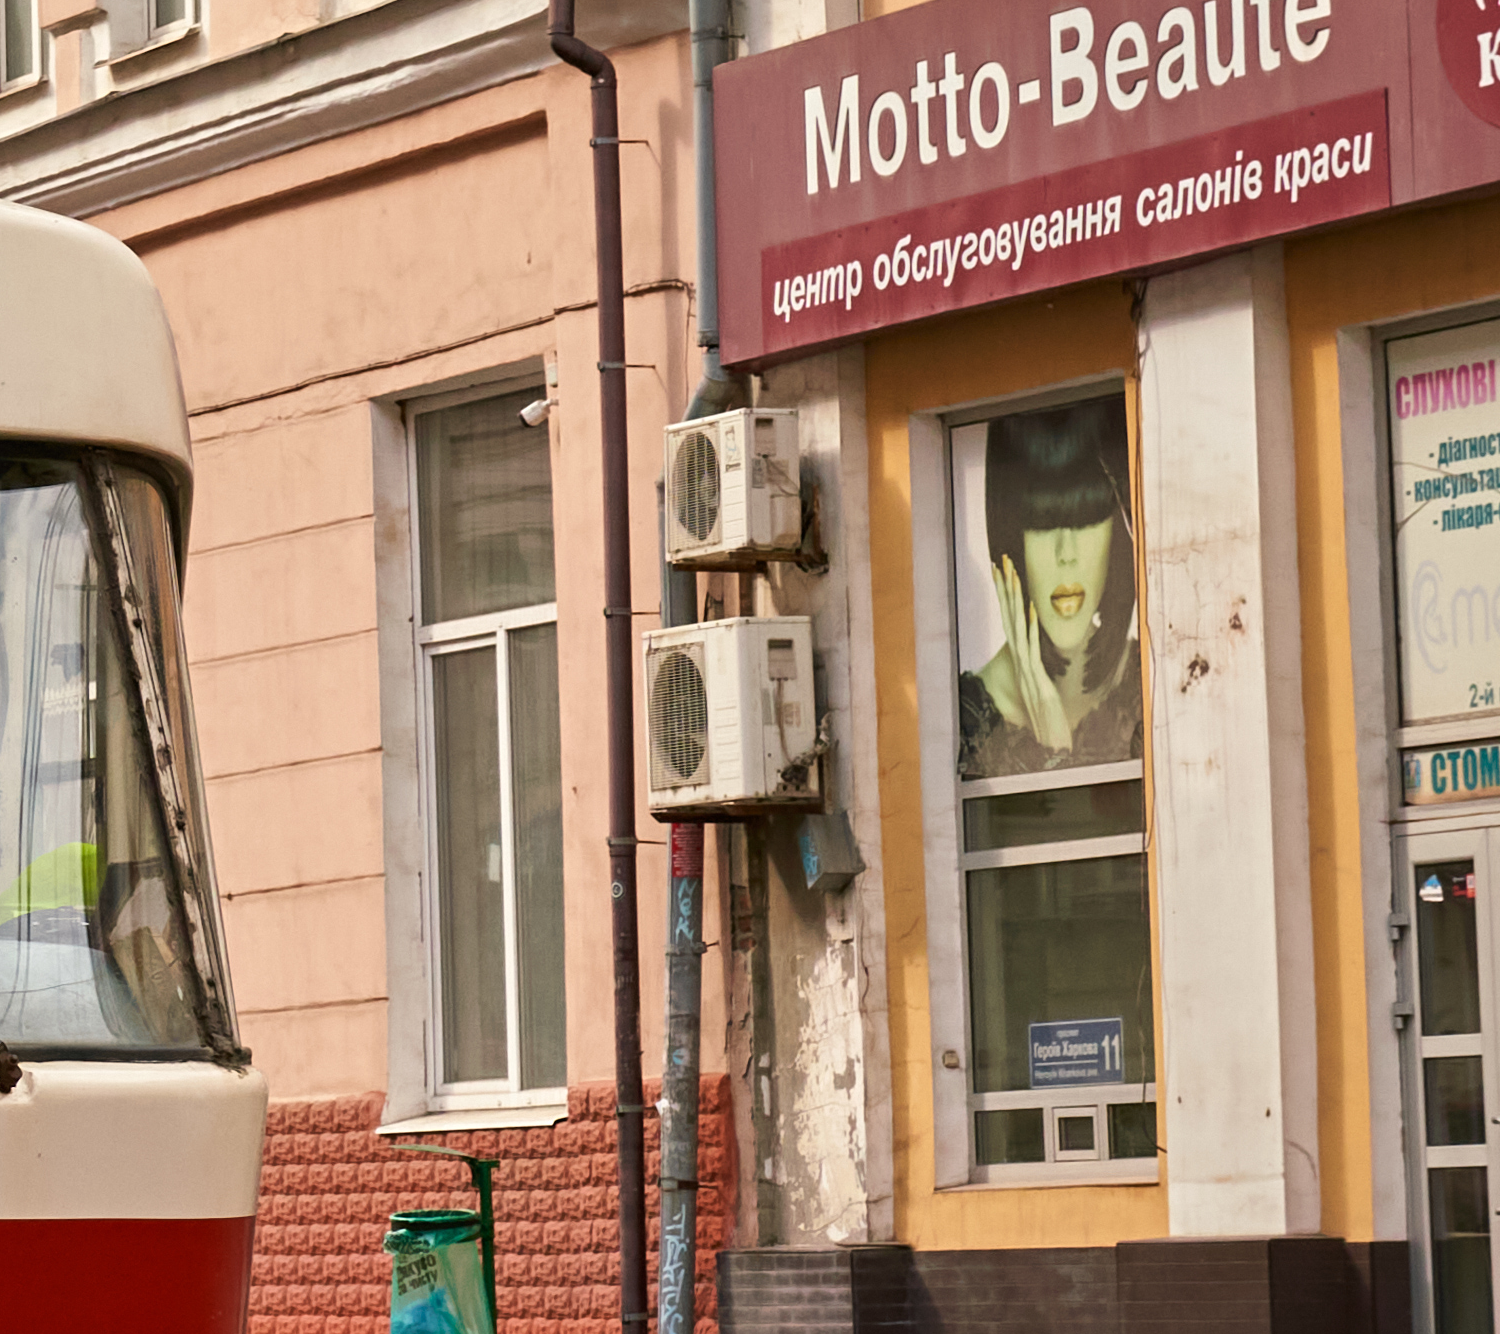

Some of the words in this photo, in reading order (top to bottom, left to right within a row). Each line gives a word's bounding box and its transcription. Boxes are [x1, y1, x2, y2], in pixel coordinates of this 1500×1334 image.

[773, 260, 863, 322] центр
[873, 195, 1121, 287] обслуговування
[1136, 150, 1263, 226] салонів
[1274, 131, 1374, 203] краси
[1395, 359, 1496, 420] СЛУХОВІ
[1033, 1040, 1060, 1061] Героїв
[1062, 1040, 1098, 1059] Харкова
[1101, 1034, 1120, 1071] 11
